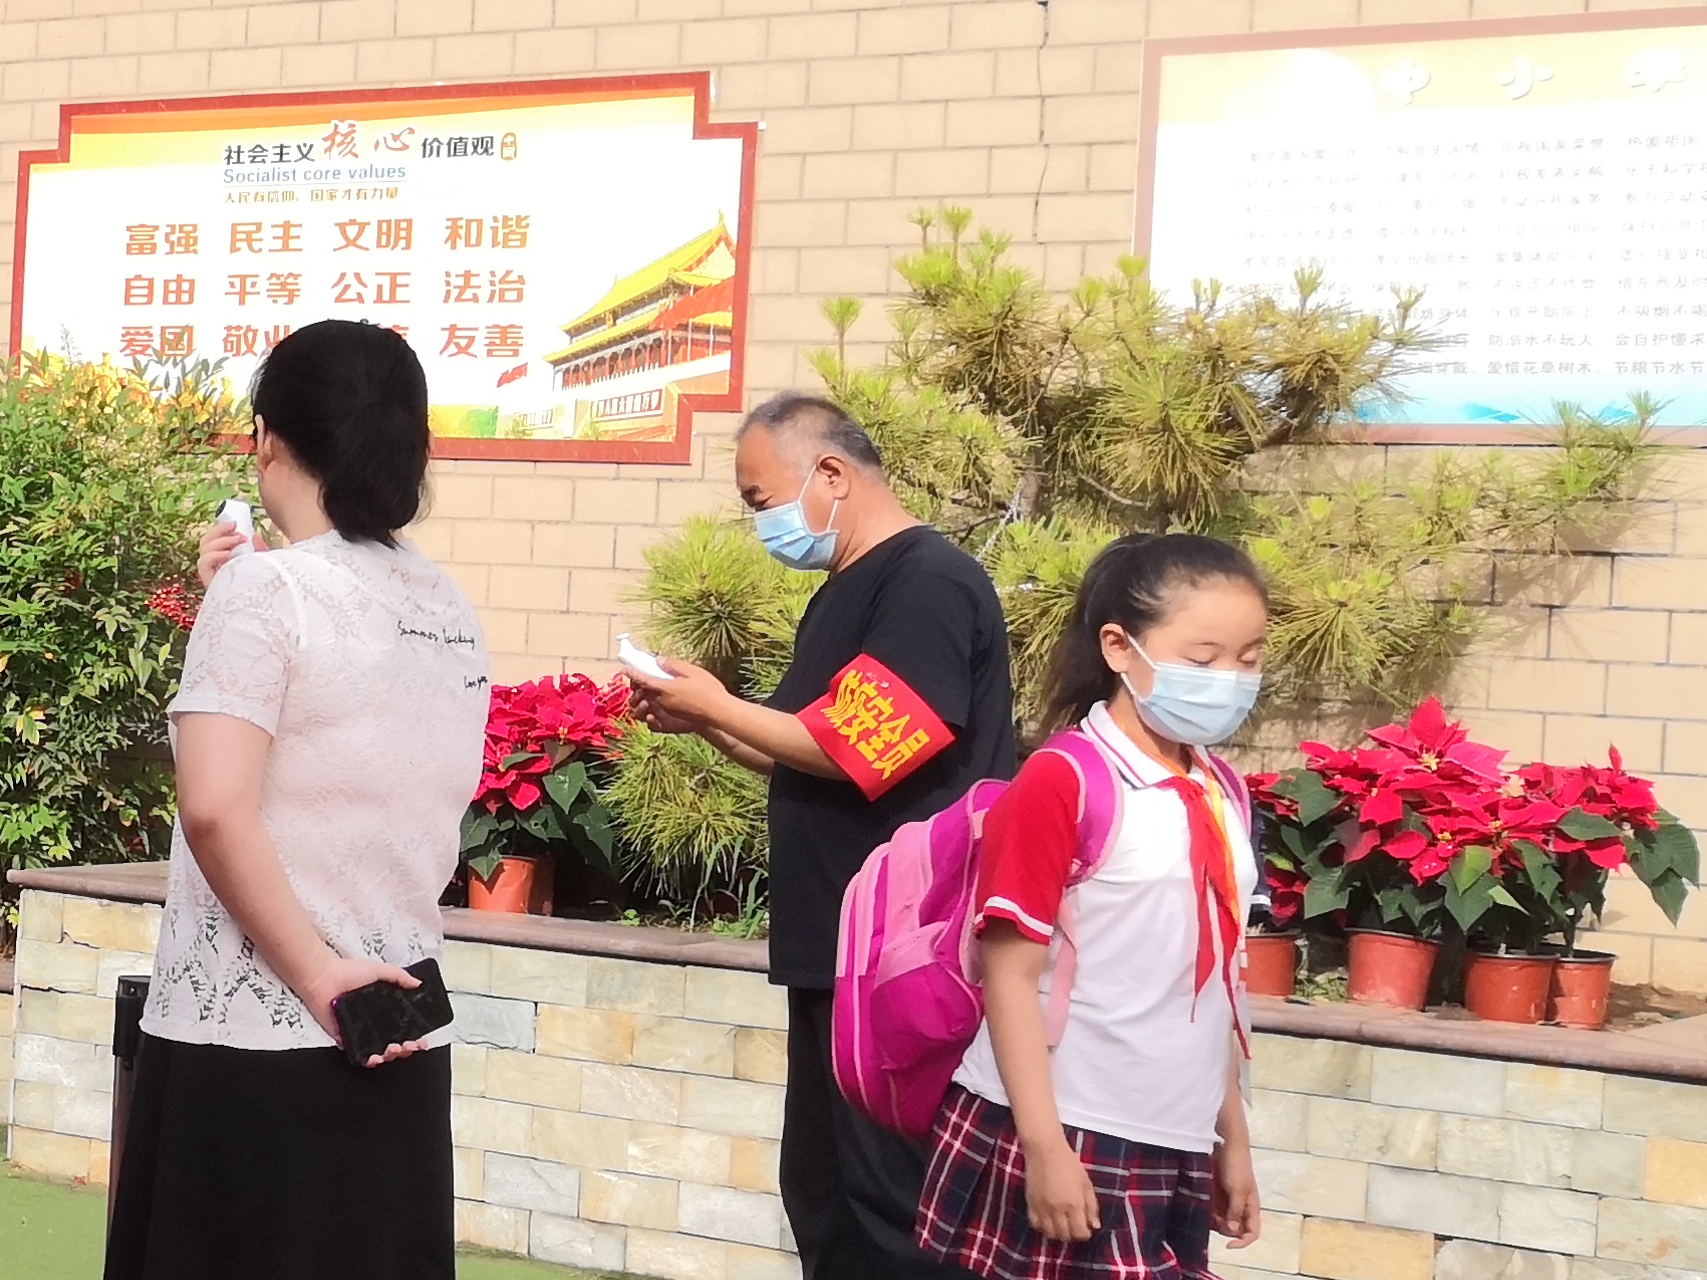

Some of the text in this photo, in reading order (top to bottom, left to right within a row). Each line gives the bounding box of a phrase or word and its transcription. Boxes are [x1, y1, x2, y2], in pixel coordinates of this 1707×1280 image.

[224, 122, 494, 166] 社会主义核心价值观
[224, 164, 406, 184] Socialist core values
[125, 214, 531, 256] 富强 民主 文明 和谐
[123, 269, 527, 306] 自由 平等 公正 法治
[119, 326, 195, 357] 爱国
[439, 324, 525, 358] 友善
